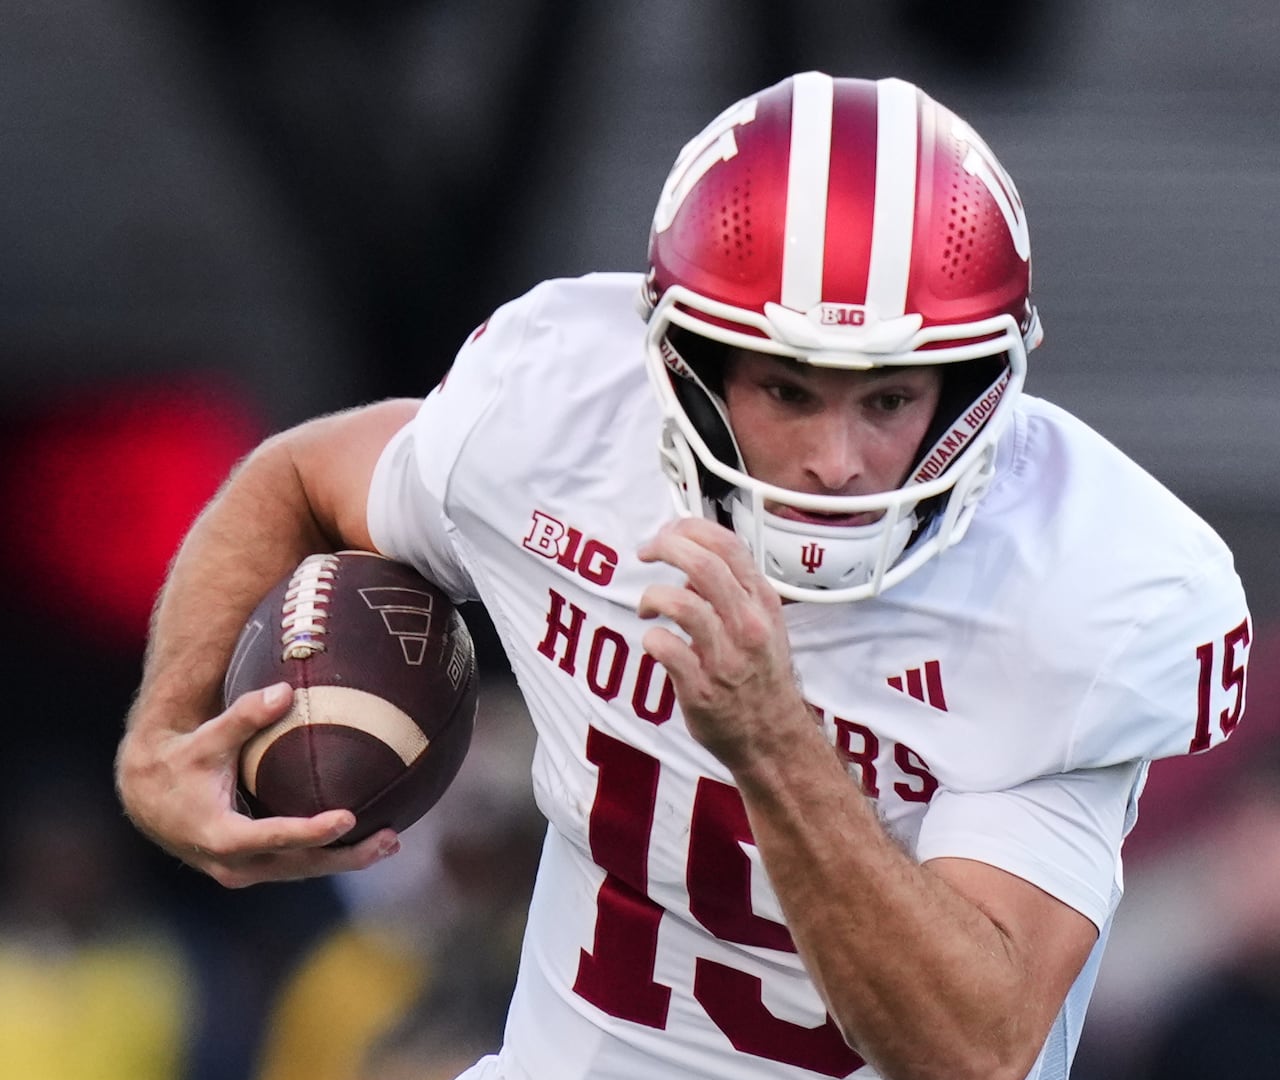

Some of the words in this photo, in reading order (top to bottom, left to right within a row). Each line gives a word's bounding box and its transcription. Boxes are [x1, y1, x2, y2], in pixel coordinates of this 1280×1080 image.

[914, 429, 969, 484] INDIANA
[538, 588, 939, 803] HOORS
[1189, 616, 1250, 754] 15
[572, 723, 866, 1080] 15
